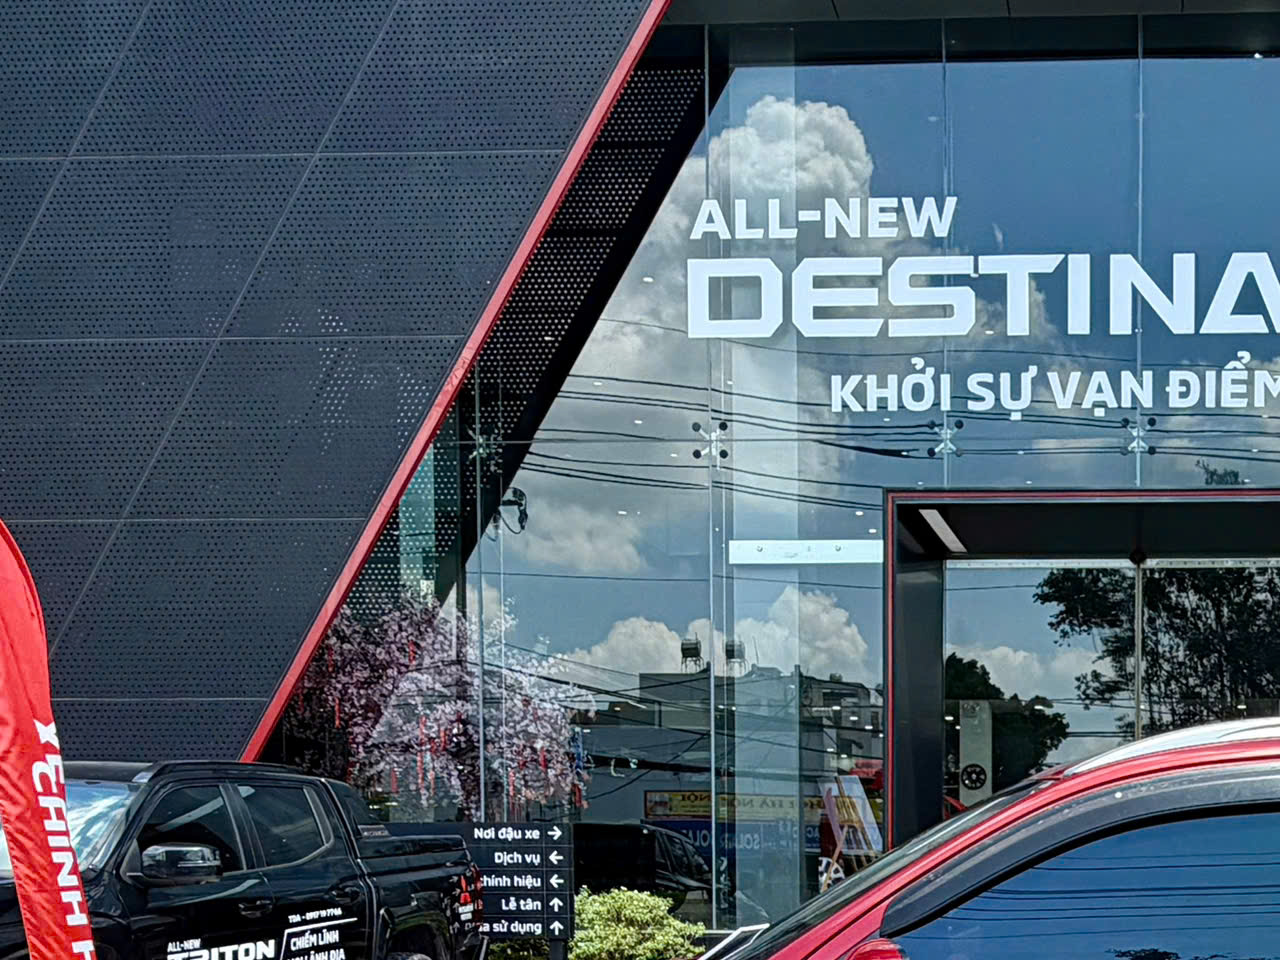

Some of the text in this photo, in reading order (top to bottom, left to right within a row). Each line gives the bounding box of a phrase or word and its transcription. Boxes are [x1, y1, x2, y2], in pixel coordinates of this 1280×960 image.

[689, 195, 958, 241] ALL-NEW
[831, 356, 953, 413] KHỞI
[967, 364, 1042, 421] SỰ
[1049, 369, 1156, 419] VẠN
[474, 826, 540, 840] Nơi đậu xe
[494, 852, 541, 866] Dịch vụ
[514, 874, 541, 889] hiệu
[502, 896, 542, 910] Lễ tân
[492, 920, 508, 932] sử
[510, 920, 542, 936] dụng
[167, 938, 202, 953] ALL-NEW
[290, 928, 340, 951] CHIẾM LĨNH
